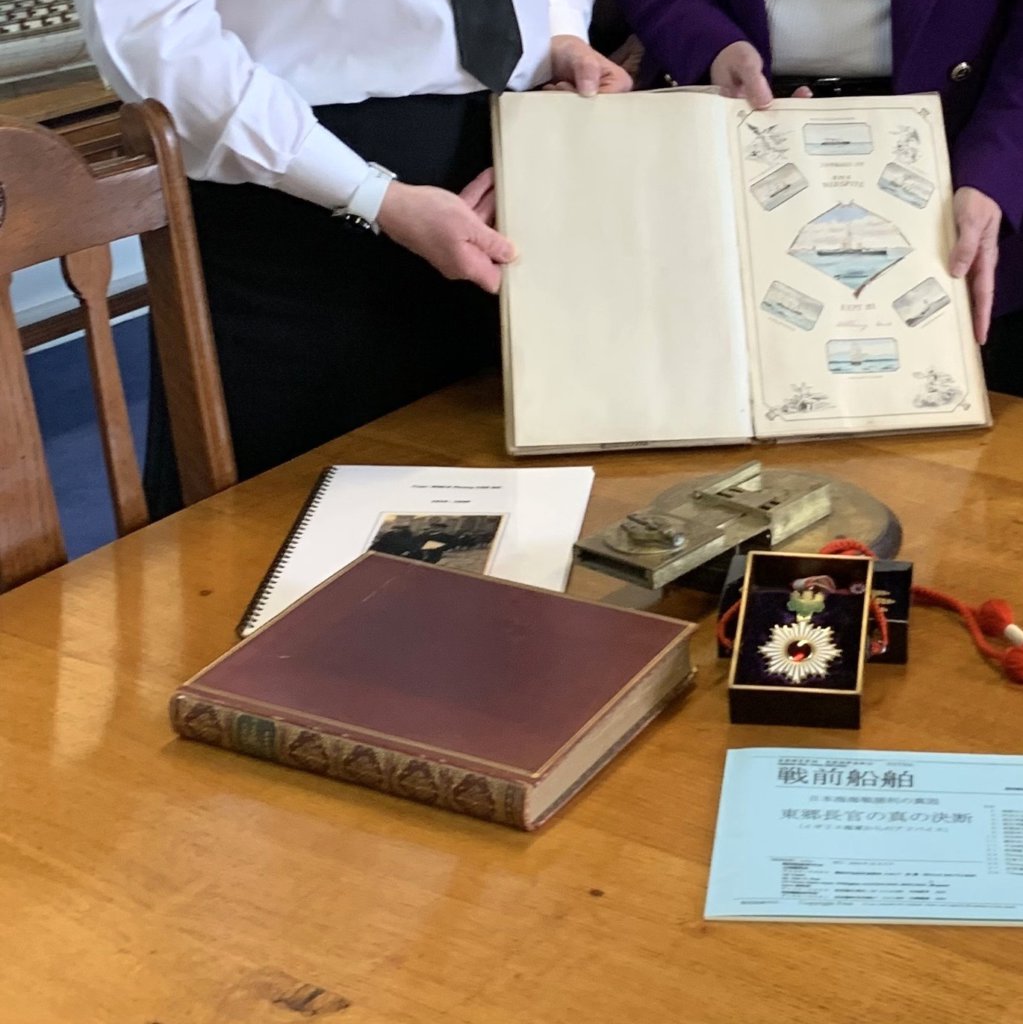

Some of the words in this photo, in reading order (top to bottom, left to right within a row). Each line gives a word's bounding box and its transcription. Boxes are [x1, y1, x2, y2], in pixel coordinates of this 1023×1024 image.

[777, 766, 914, 788] 戦前船舶
[780, 808, 974, 824] 東郷長官の真の決断
